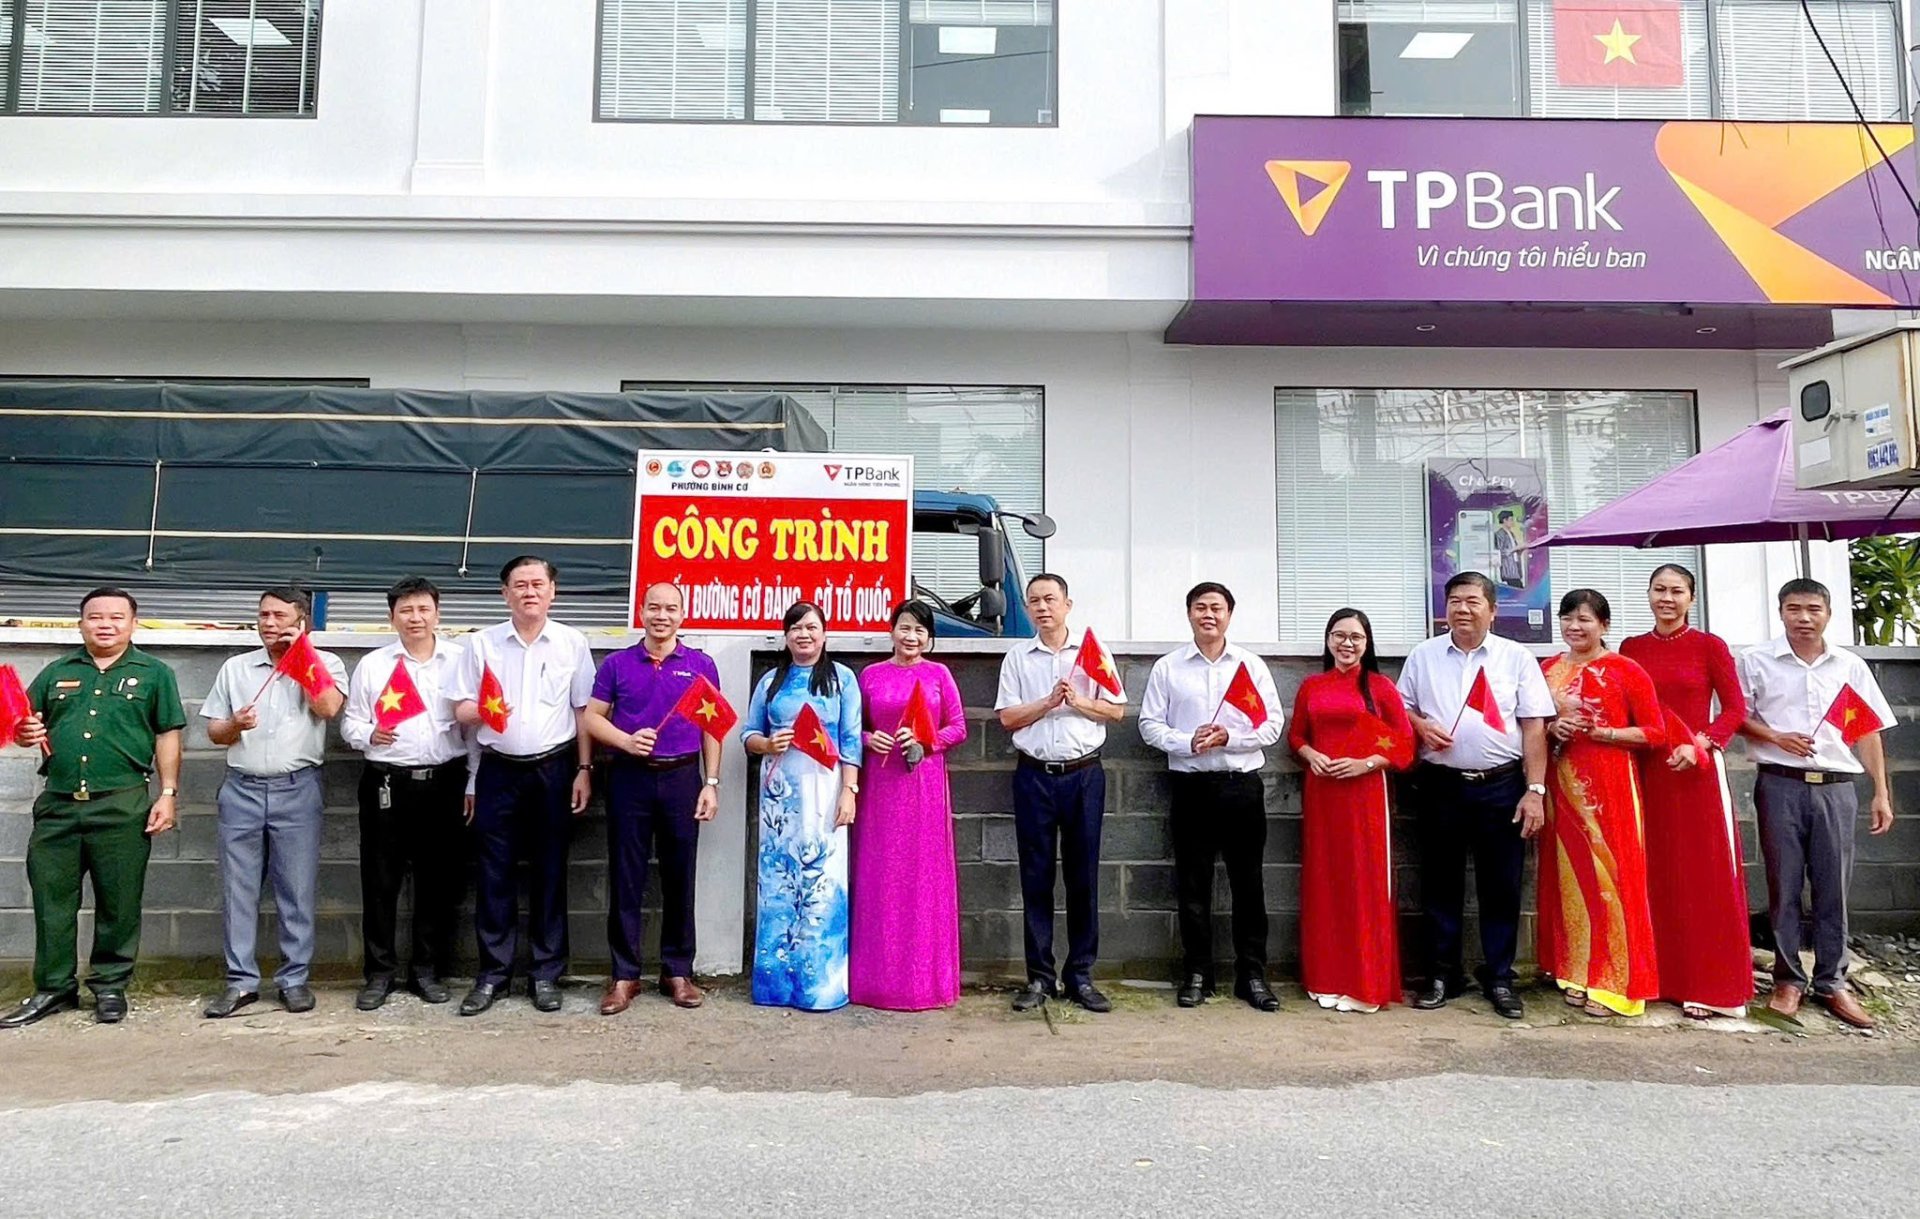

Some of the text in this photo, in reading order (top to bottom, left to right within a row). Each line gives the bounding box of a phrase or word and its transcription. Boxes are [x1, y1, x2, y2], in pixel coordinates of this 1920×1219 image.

[1367, 170, 1624, 231] TPBank
[1417, 245, 1439, 266] Vì
[1444, 246, 1511, 271] chúng
[1518, 246, 1547, 267] tôi
[1552, 241, 1599, 267] hiểu
[711, 481, 734, 491] BÌNH
[844, 466, 900, 481] TPBank
[653, 504, 889, 562] CÔNG TRÌNH
[692, 576, 740, 620] ĐƯỜNG
[742, 577, 762, 620] CỜ
[855, 575, 892, 625] QUỐC
